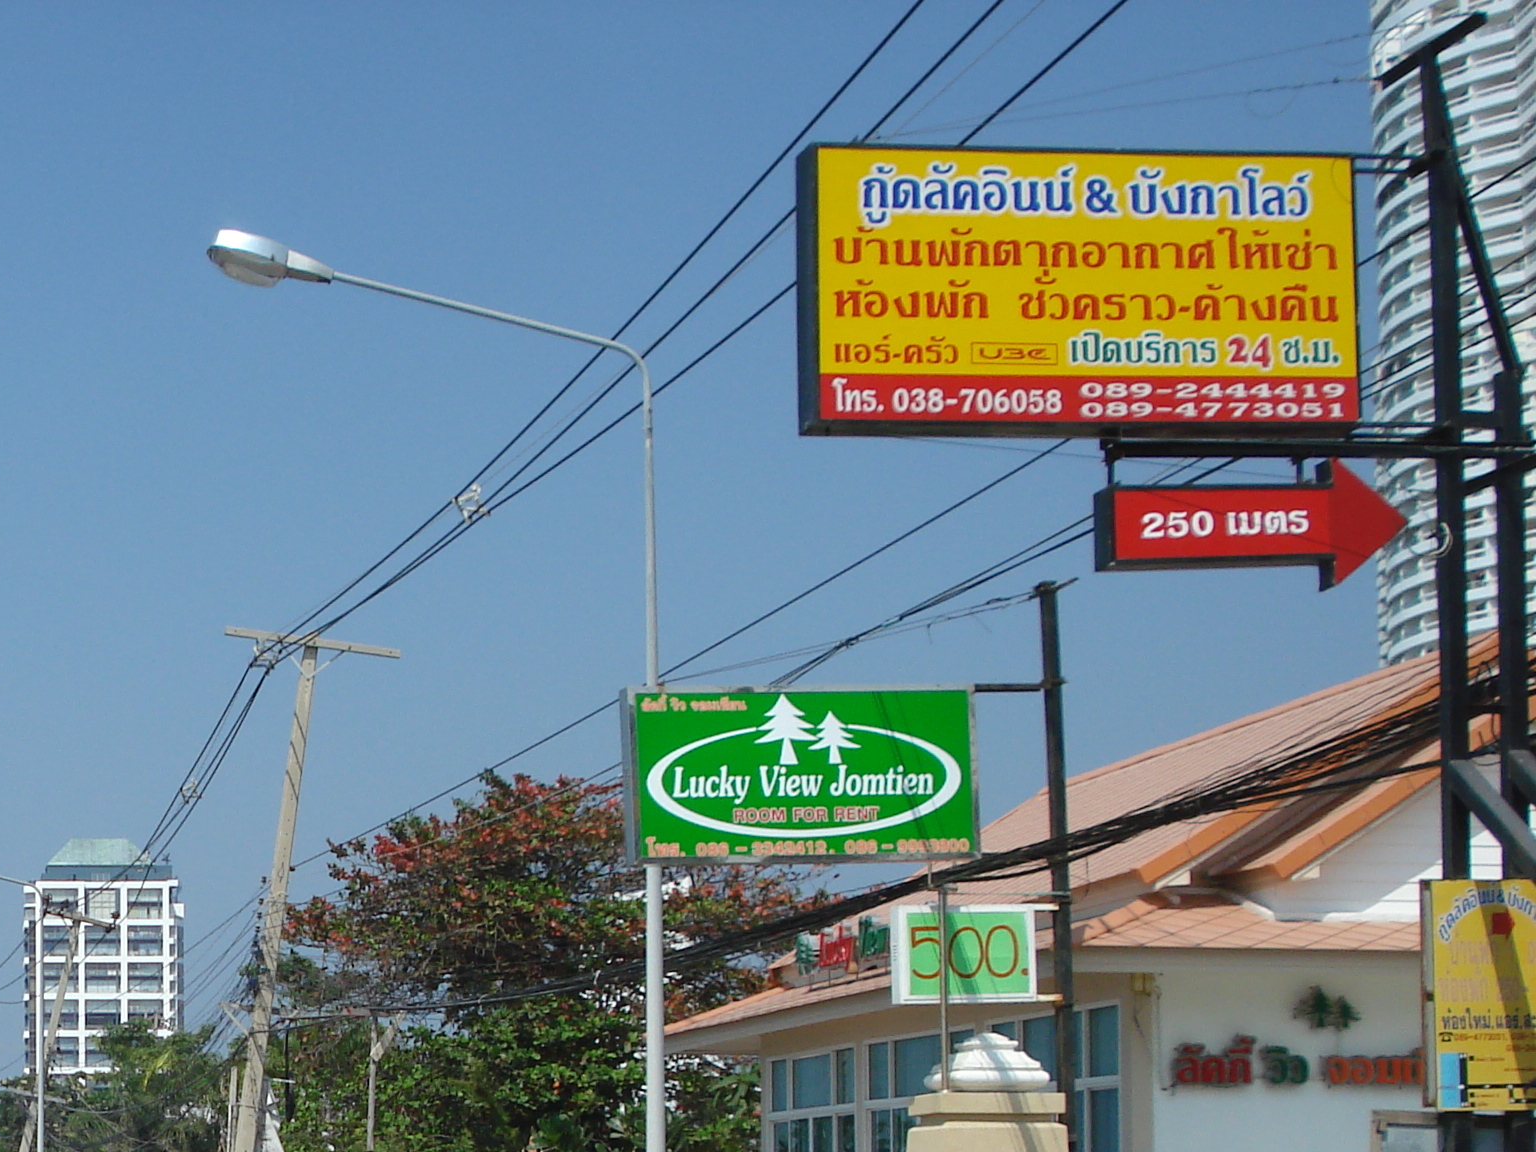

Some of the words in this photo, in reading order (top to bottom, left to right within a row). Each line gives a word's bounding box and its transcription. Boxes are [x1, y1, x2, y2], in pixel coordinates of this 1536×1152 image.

[1084, 177, 1119, 214] &
[1128, 167, 1311, 217] บังกาโลว์
[832, 279, 990, 319] ห้องพัก
[1018, 269, 1339, 322] ชั่วคราว-ค้างคืน
[833, 334, 960, 364] แอร์-ครัว
[1069, 331, 1216, 365] เปิดบริการ
[1227, 336, 1272, 370] 24
[1281, 338, 1341, 365] ช.ม.
[831, 377, 885, 413] โทร.
[891, 387, 1063, 414] 038-706058
[1078, 381, 1346, 400] 089-2444419
[1078, 401, 1345, 420] 089-4773051
[1140, 510, 1215, 539] 250
[1225, 509, 1310, 536] เมตร
[671, 764, 751, 805] Lucky
[758, 765, 824, 798] View
[828, 764, 935, 797] Jomtien
[732, 806, 787, 824] ROOM
[791, 806, 828, 823] FOR
[833, 805, 880, 822] RENT
[1174, 1035, 1254, 1084] ลัคกี้
[1263, 1046, 1310, 1085] วิว
